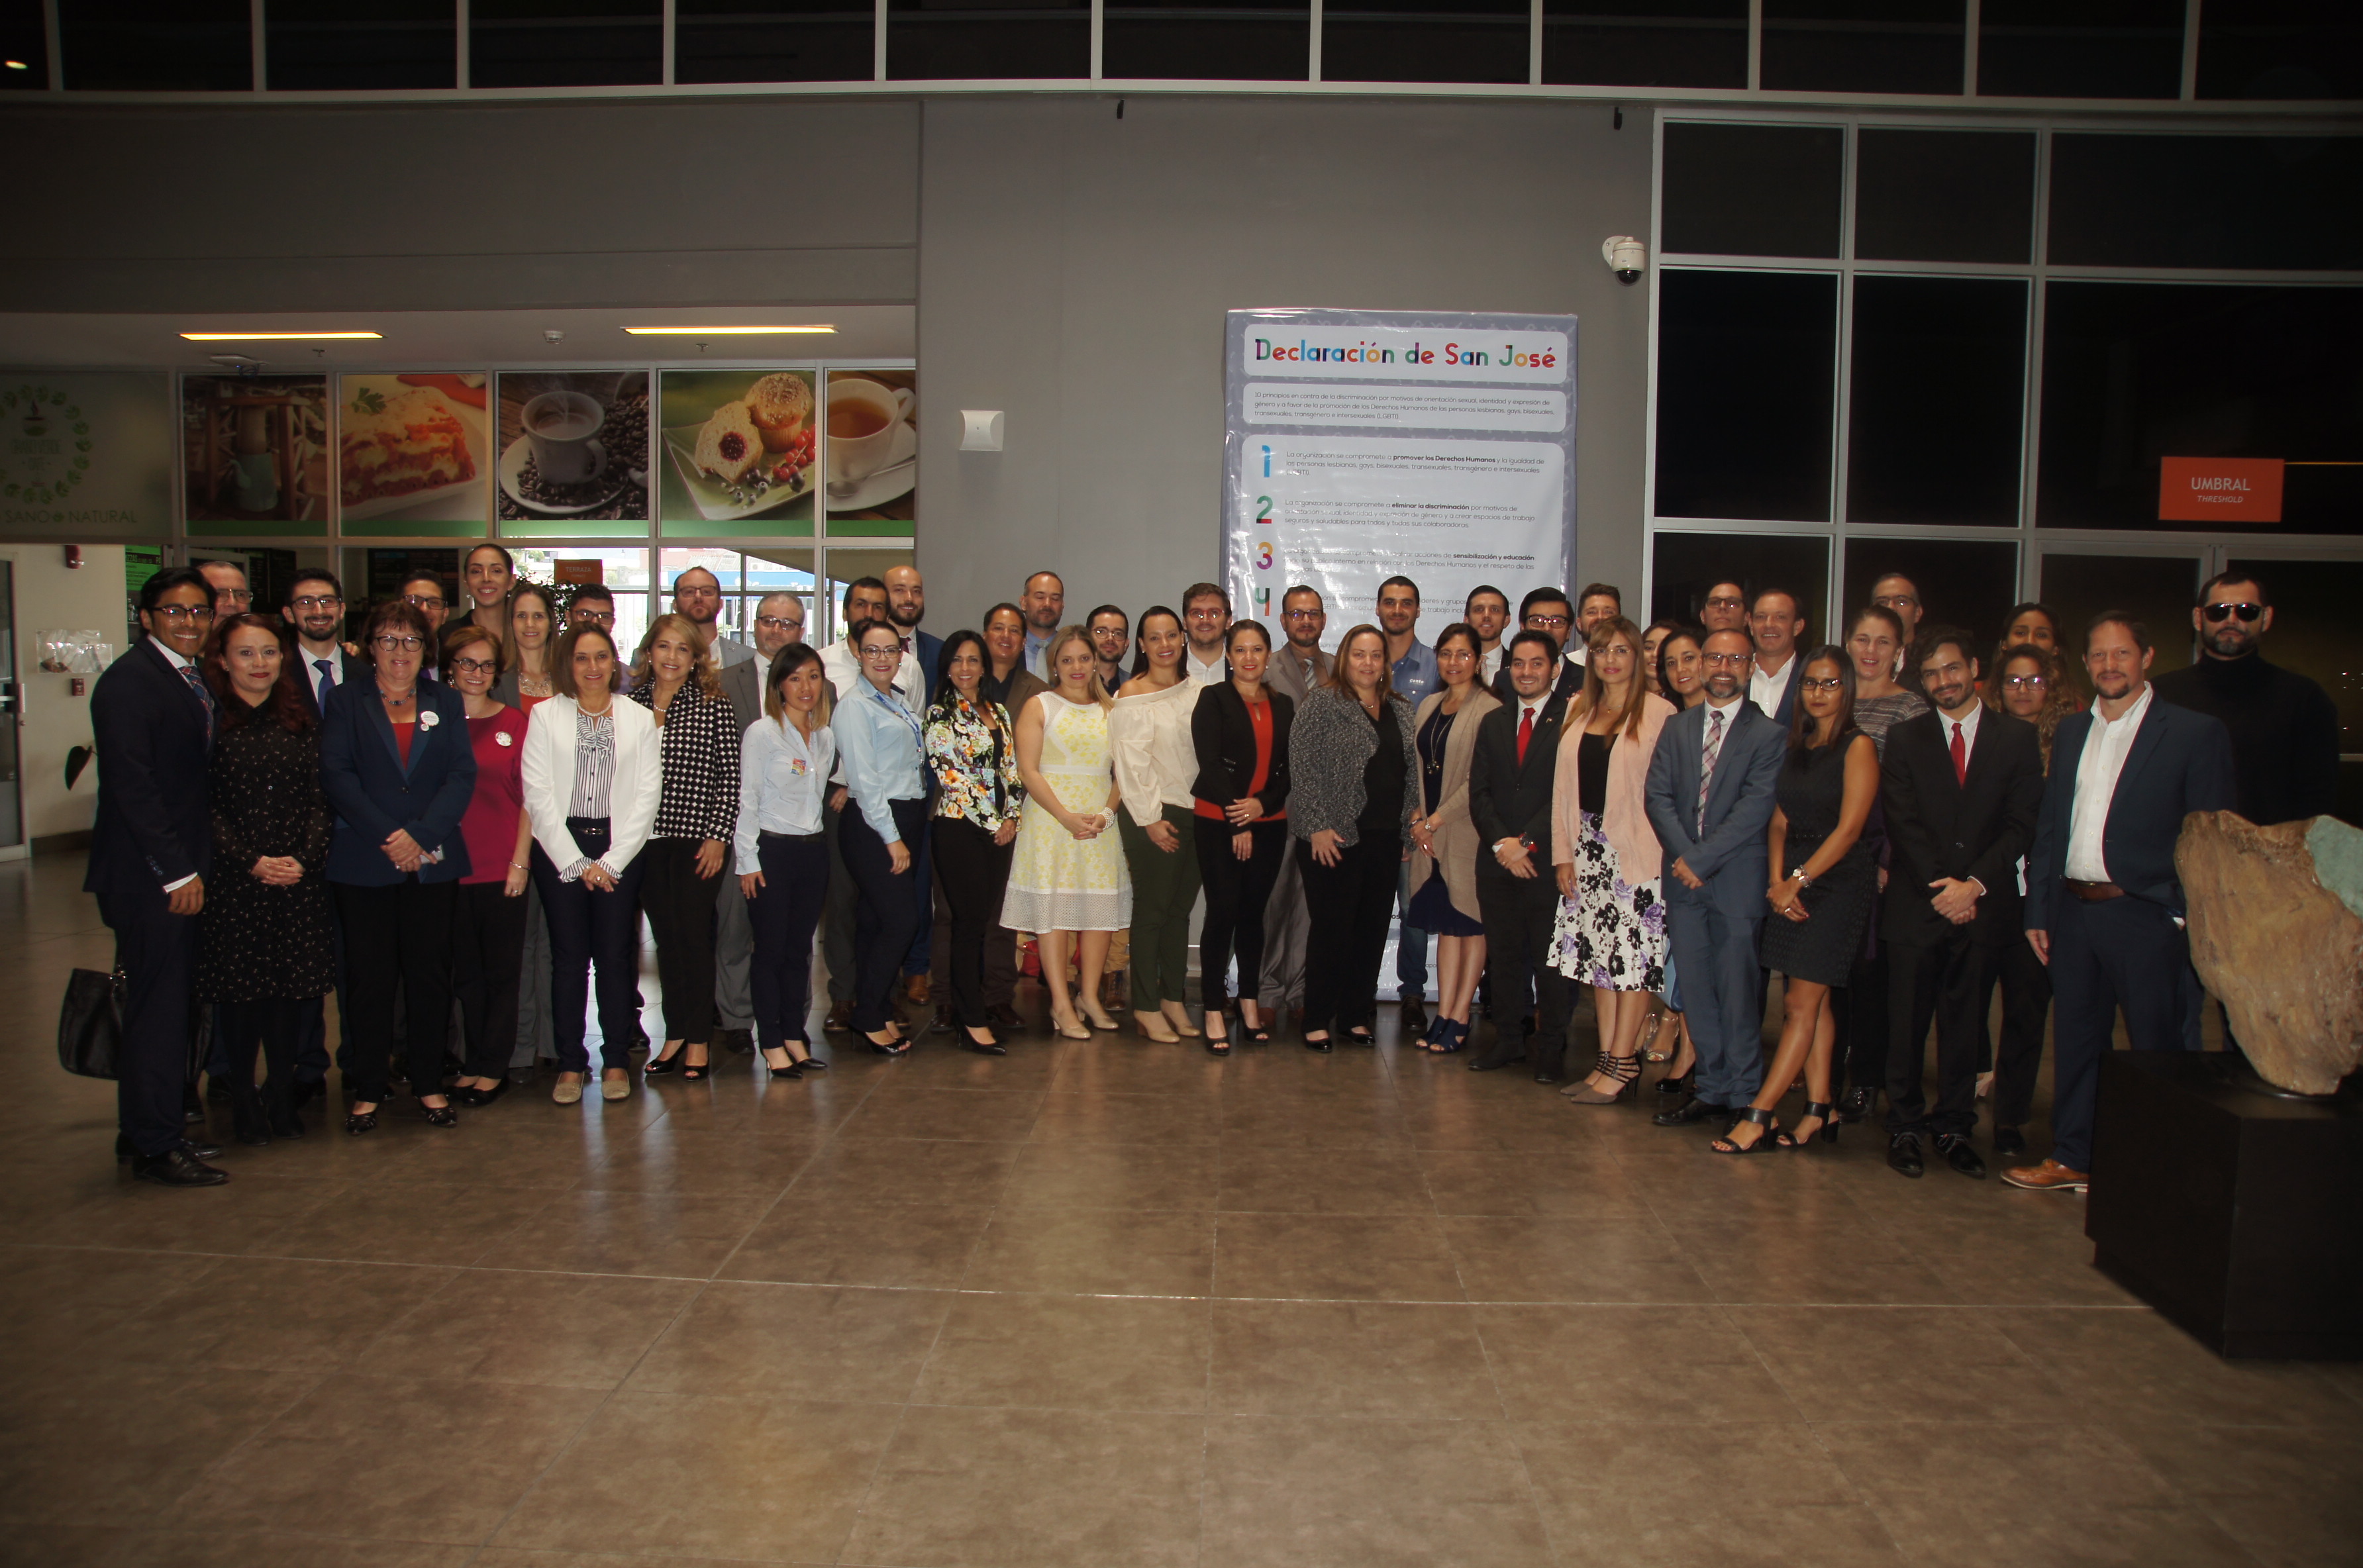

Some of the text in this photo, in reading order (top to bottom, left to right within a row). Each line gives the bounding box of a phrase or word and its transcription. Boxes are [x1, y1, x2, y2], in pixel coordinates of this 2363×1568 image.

[1255, 338, 1556, 368] Declaración de San José
[1262, 444, 1271, 478] 1
[2191, 477, 2251, 491] UMBRAL
[5, 510, 138, 524] SANO NATURAL
[1256, 495, 1274, 524] 2
[1256, 541, 1274, 570] 3
[1254, 587, 1270, 616] 4
